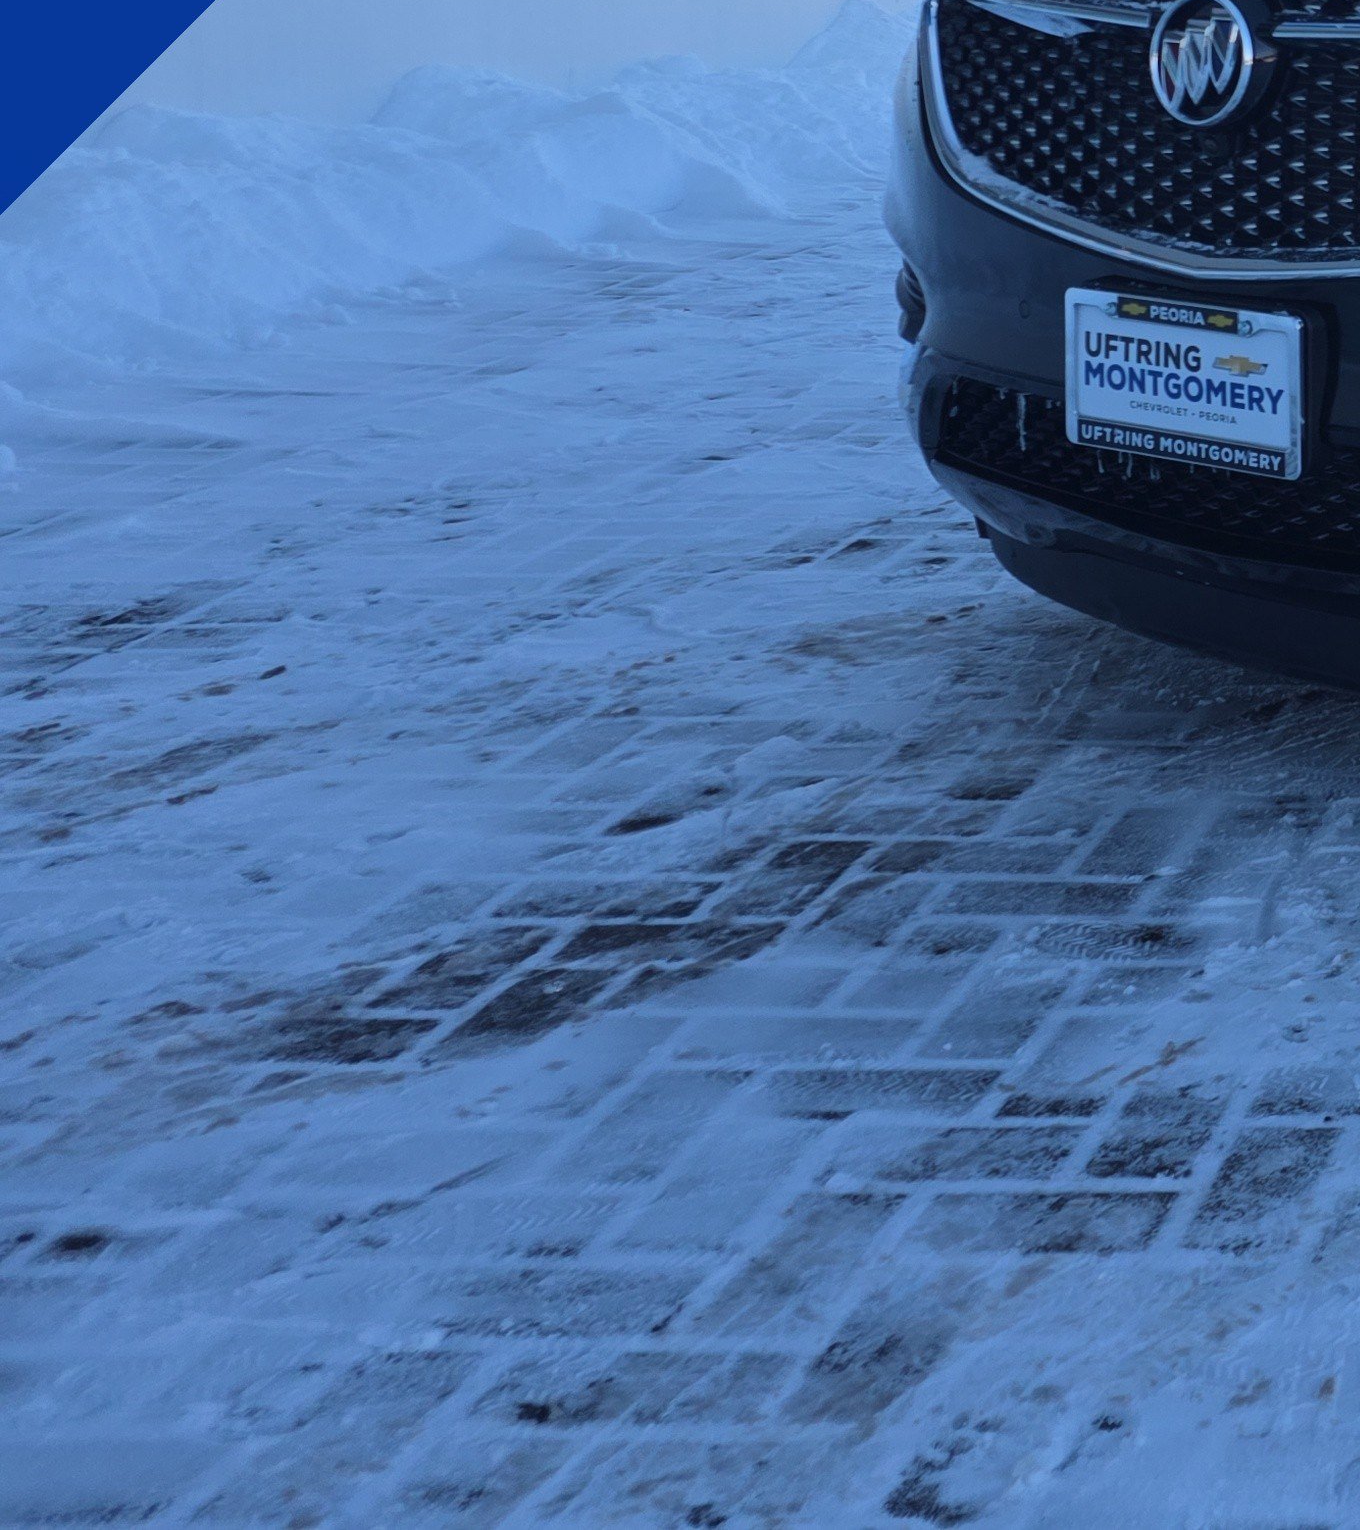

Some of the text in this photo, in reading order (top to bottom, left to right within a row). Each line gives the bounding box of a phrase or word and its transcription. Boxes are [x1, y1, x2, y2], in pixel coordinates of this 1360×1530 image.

[1150, 304, 1206, 326] PEORIA
[1084, 330, 1203, 373] UFTRING
[1083, 360, 1285, 415] MONTGOMERY
[1129, 400, 1238, 425] CHEVROLET PEORIA
[1080, 424, 1282, 471] UFTRING MONTGOMERY
